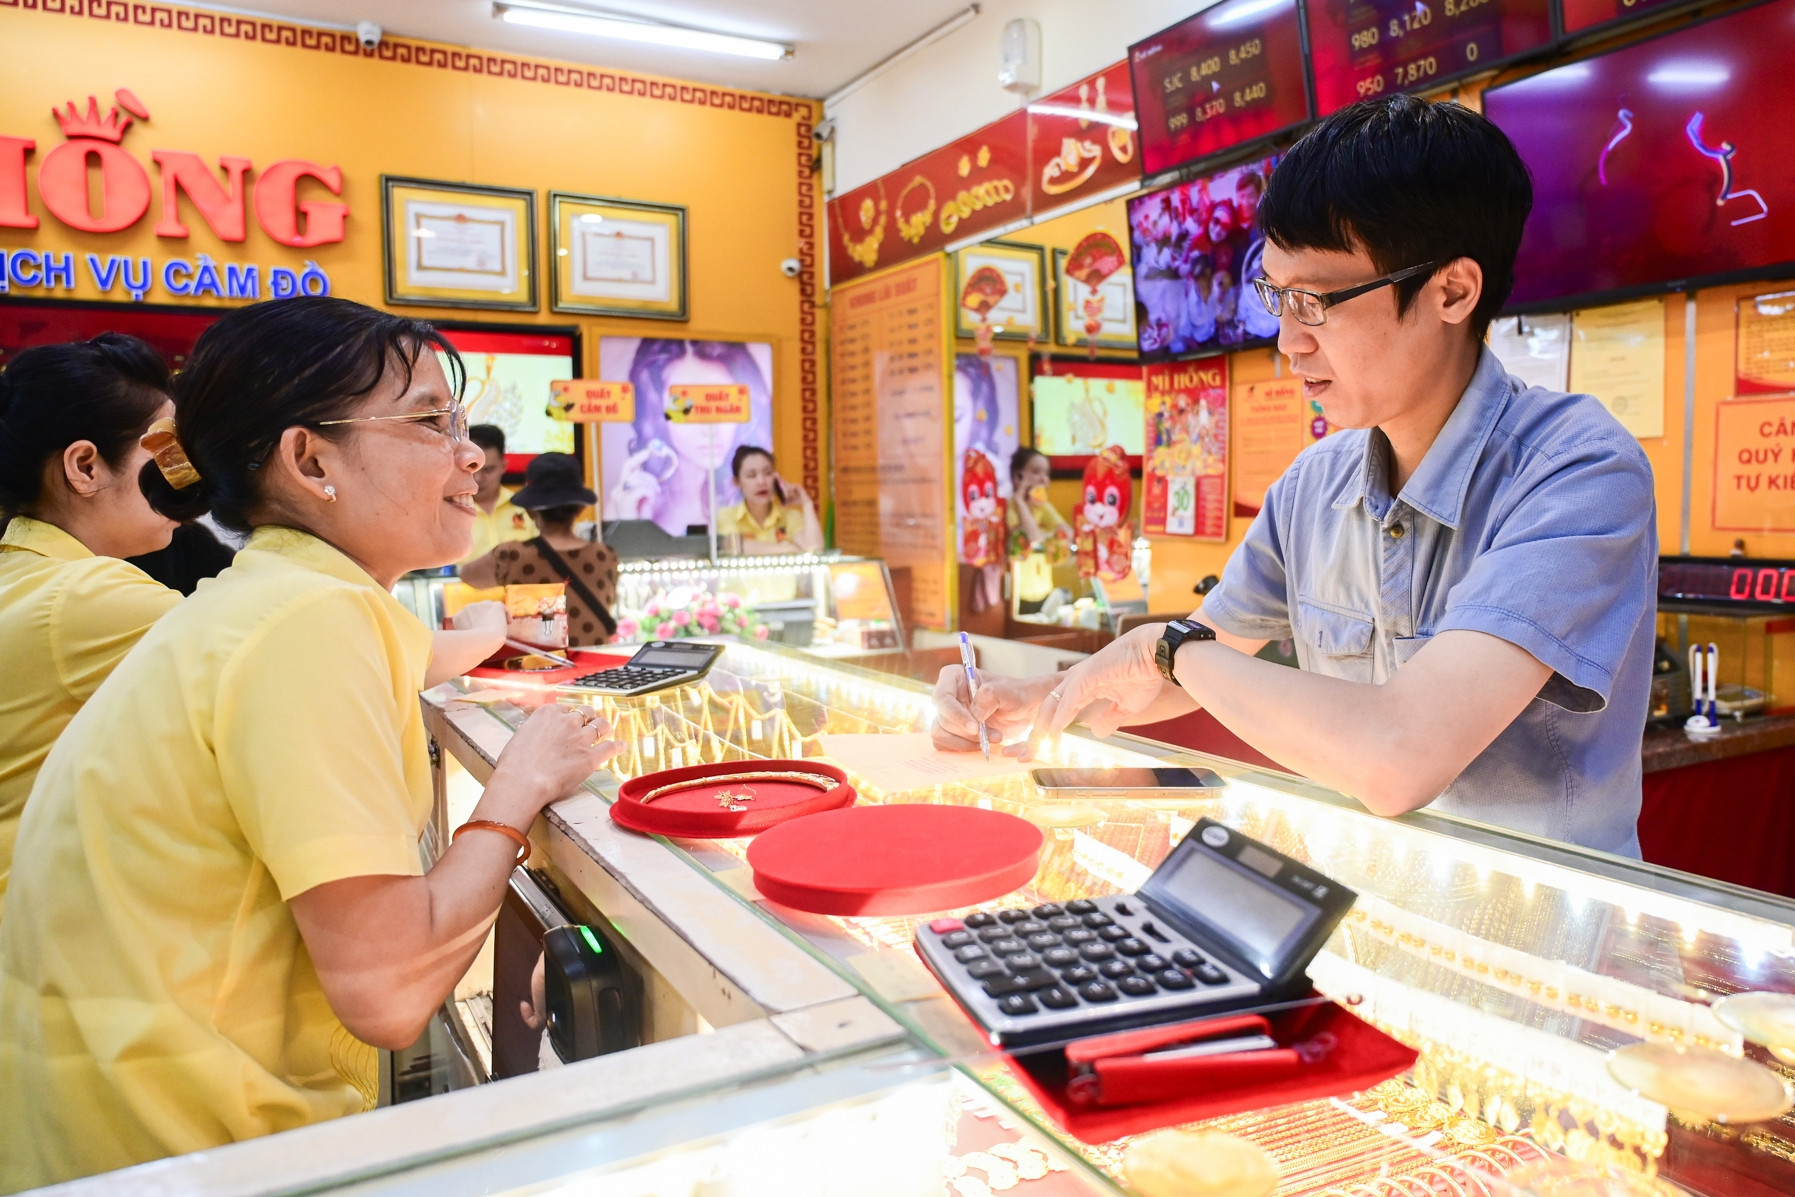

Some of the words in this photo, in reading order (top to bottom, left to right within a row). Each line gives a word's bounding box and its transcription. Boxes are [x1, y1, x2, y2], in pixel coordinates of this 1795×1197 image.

[1351, 26, 1379, 50] 980
[1389, 7, 1432, 37] 8,120
[1163, 71, 1184, 93] SJC
[1190, 56, 1221, 82] 8,400
[1228, 38, 1262, 65] 8,450
[1356, 74, 1386, 97] 950
[1394, 56, 1437, 87] 7,870
[1466, 42, 1478, 61] 0
[1168, 112, 1189, 131] 999
[1195, 99, 1226, 122] 8,370
[1233, 81, 1267, 108] 8,440
[86, 254, 152, 301] VỤ
[163, 253, 259, 299] CẦM
[267, 260, 331, 299] ĐỒ
[1738, 443, 1782, 465] QUÝ
[1733, 472, 1762, 493] TỰ
